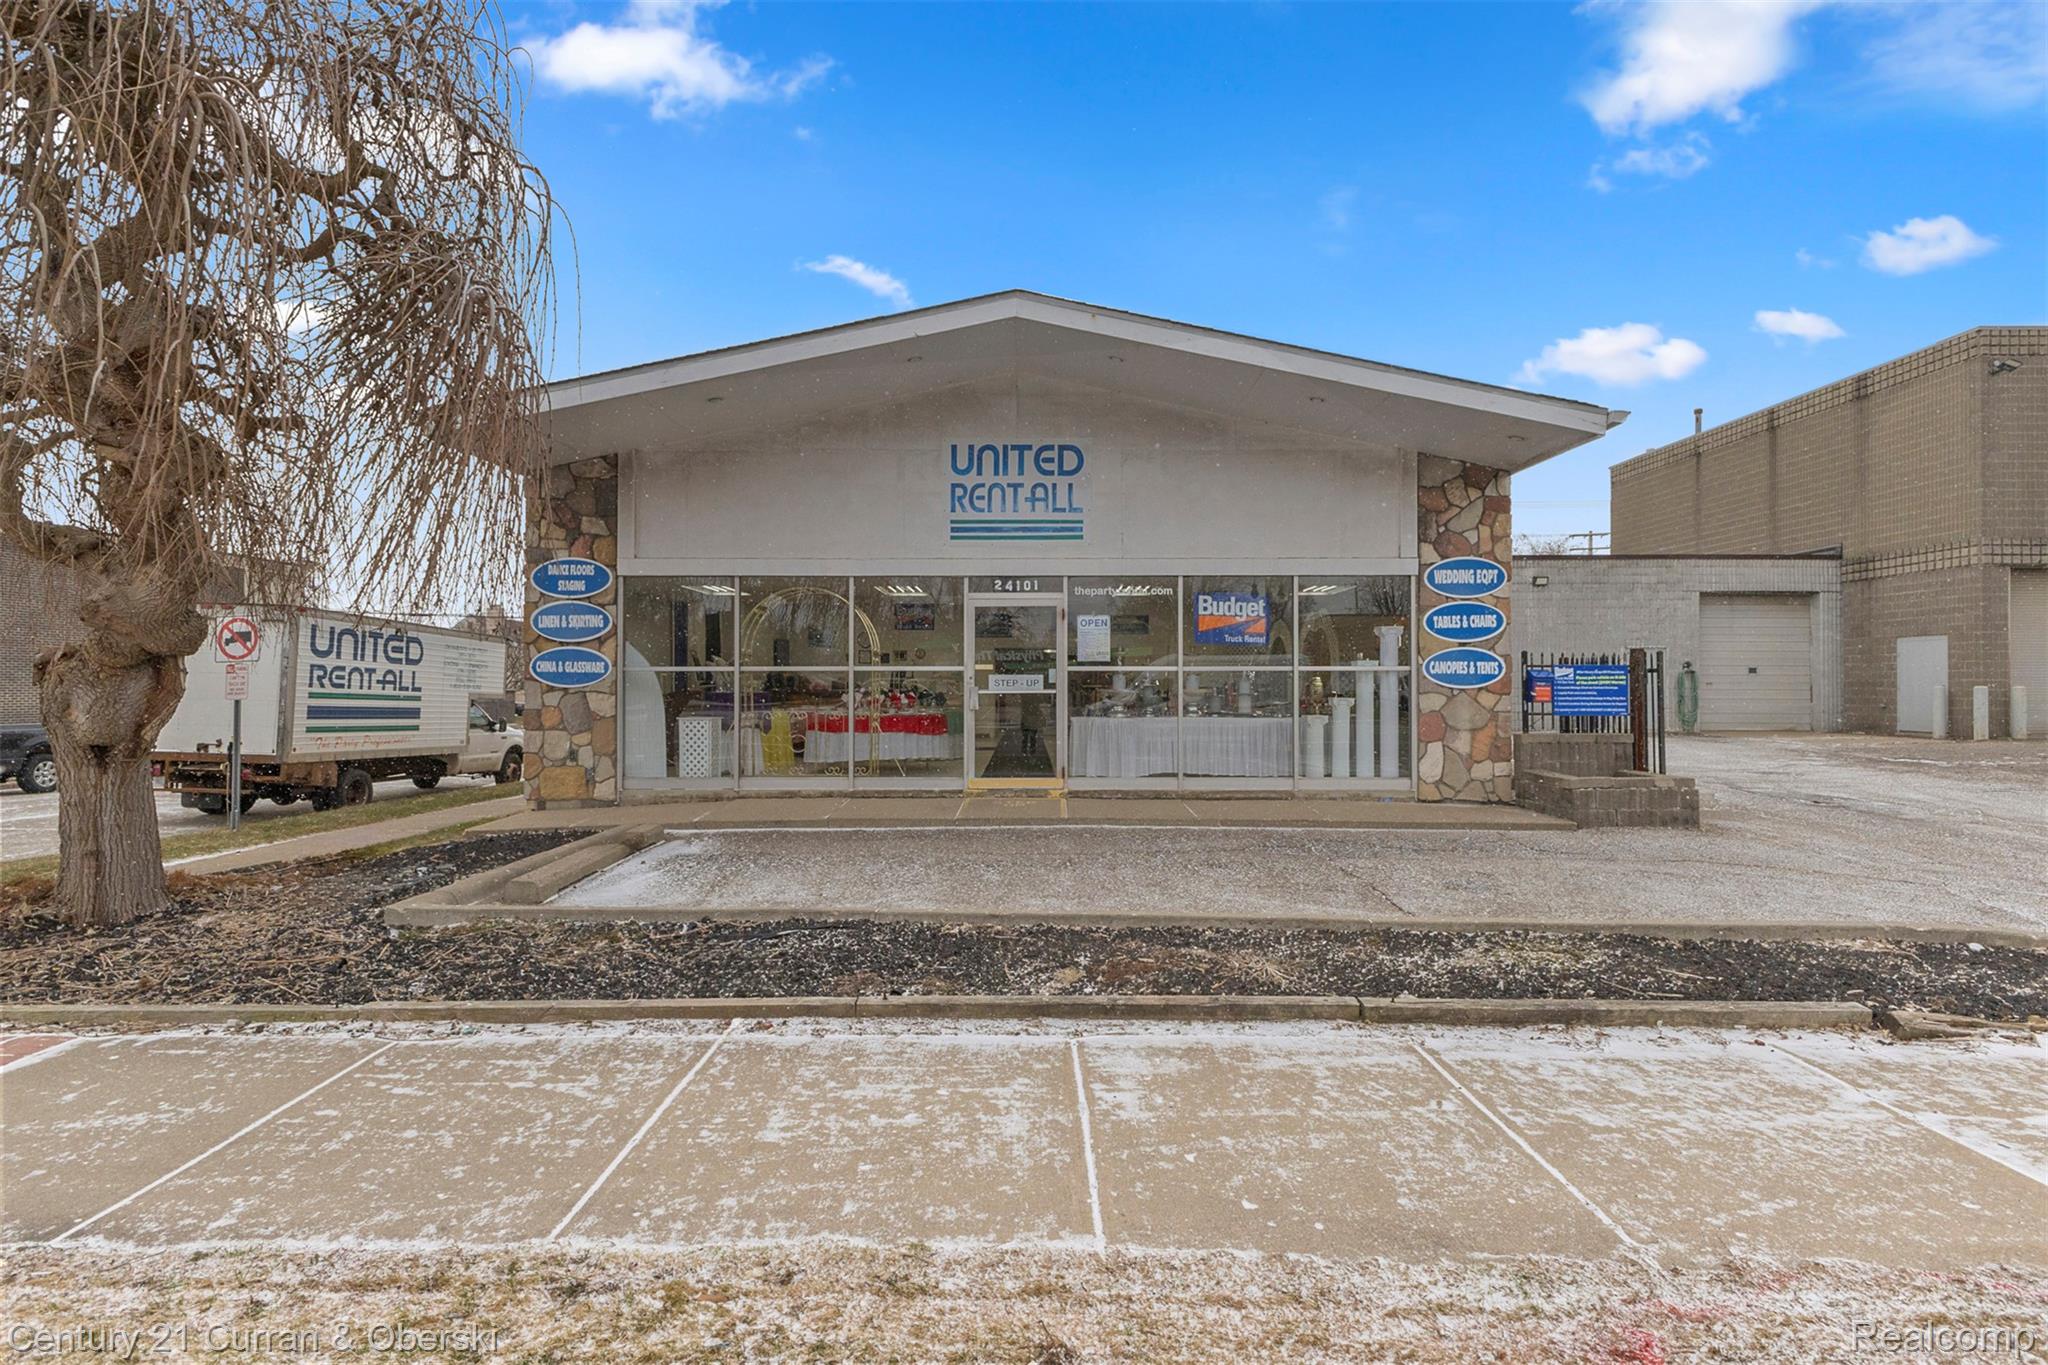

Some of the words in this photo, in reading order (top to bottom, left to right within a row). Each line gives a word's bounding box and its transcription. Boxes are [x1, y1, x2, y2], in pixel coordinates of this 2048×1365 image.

[951, 444, 1084, 476] UNITED
[548, 564, 569, 575] DANCE
[570, 564, 595, 576] FLOORS
[1433, 569, 1475, 584] WEDDING
[1476, 569, 1499, 585] EQPT
[557, 580, 586, 591] STAGING
[994, 579, 1039, 592] 24101
[1198, 595, 1266, 622] Budget
[538, 615, 560, 628] LINEN
[561, 615, 567, 627] &
[568, 615, 604, 629] SKIRTING
[1080, 618, 1108, 628] OPEN
[1433, 615, 1461, 628] TABLES
[1462, 615, 1468, 627] &
[1469, 614, 1497, 628] CHAIRS
[310, 624, 424, 666] UNITED
[1224, 634, 1243, 643] Truck
[1244, 634, 1266, 643] Rental
[535, 661, 557, 673] CHINA
[558, 661, 563, 672] &
[564, 661, 605, 673] GLASSWARE
[1429, 661, 1468, 675] CANOPIES
[1469, 661, 1475, 674] &
[1476, 661, 1499, 675] TENTS
[993, 679, 1018, 687] STEP
[1026, 679, 1040, 687] UP
